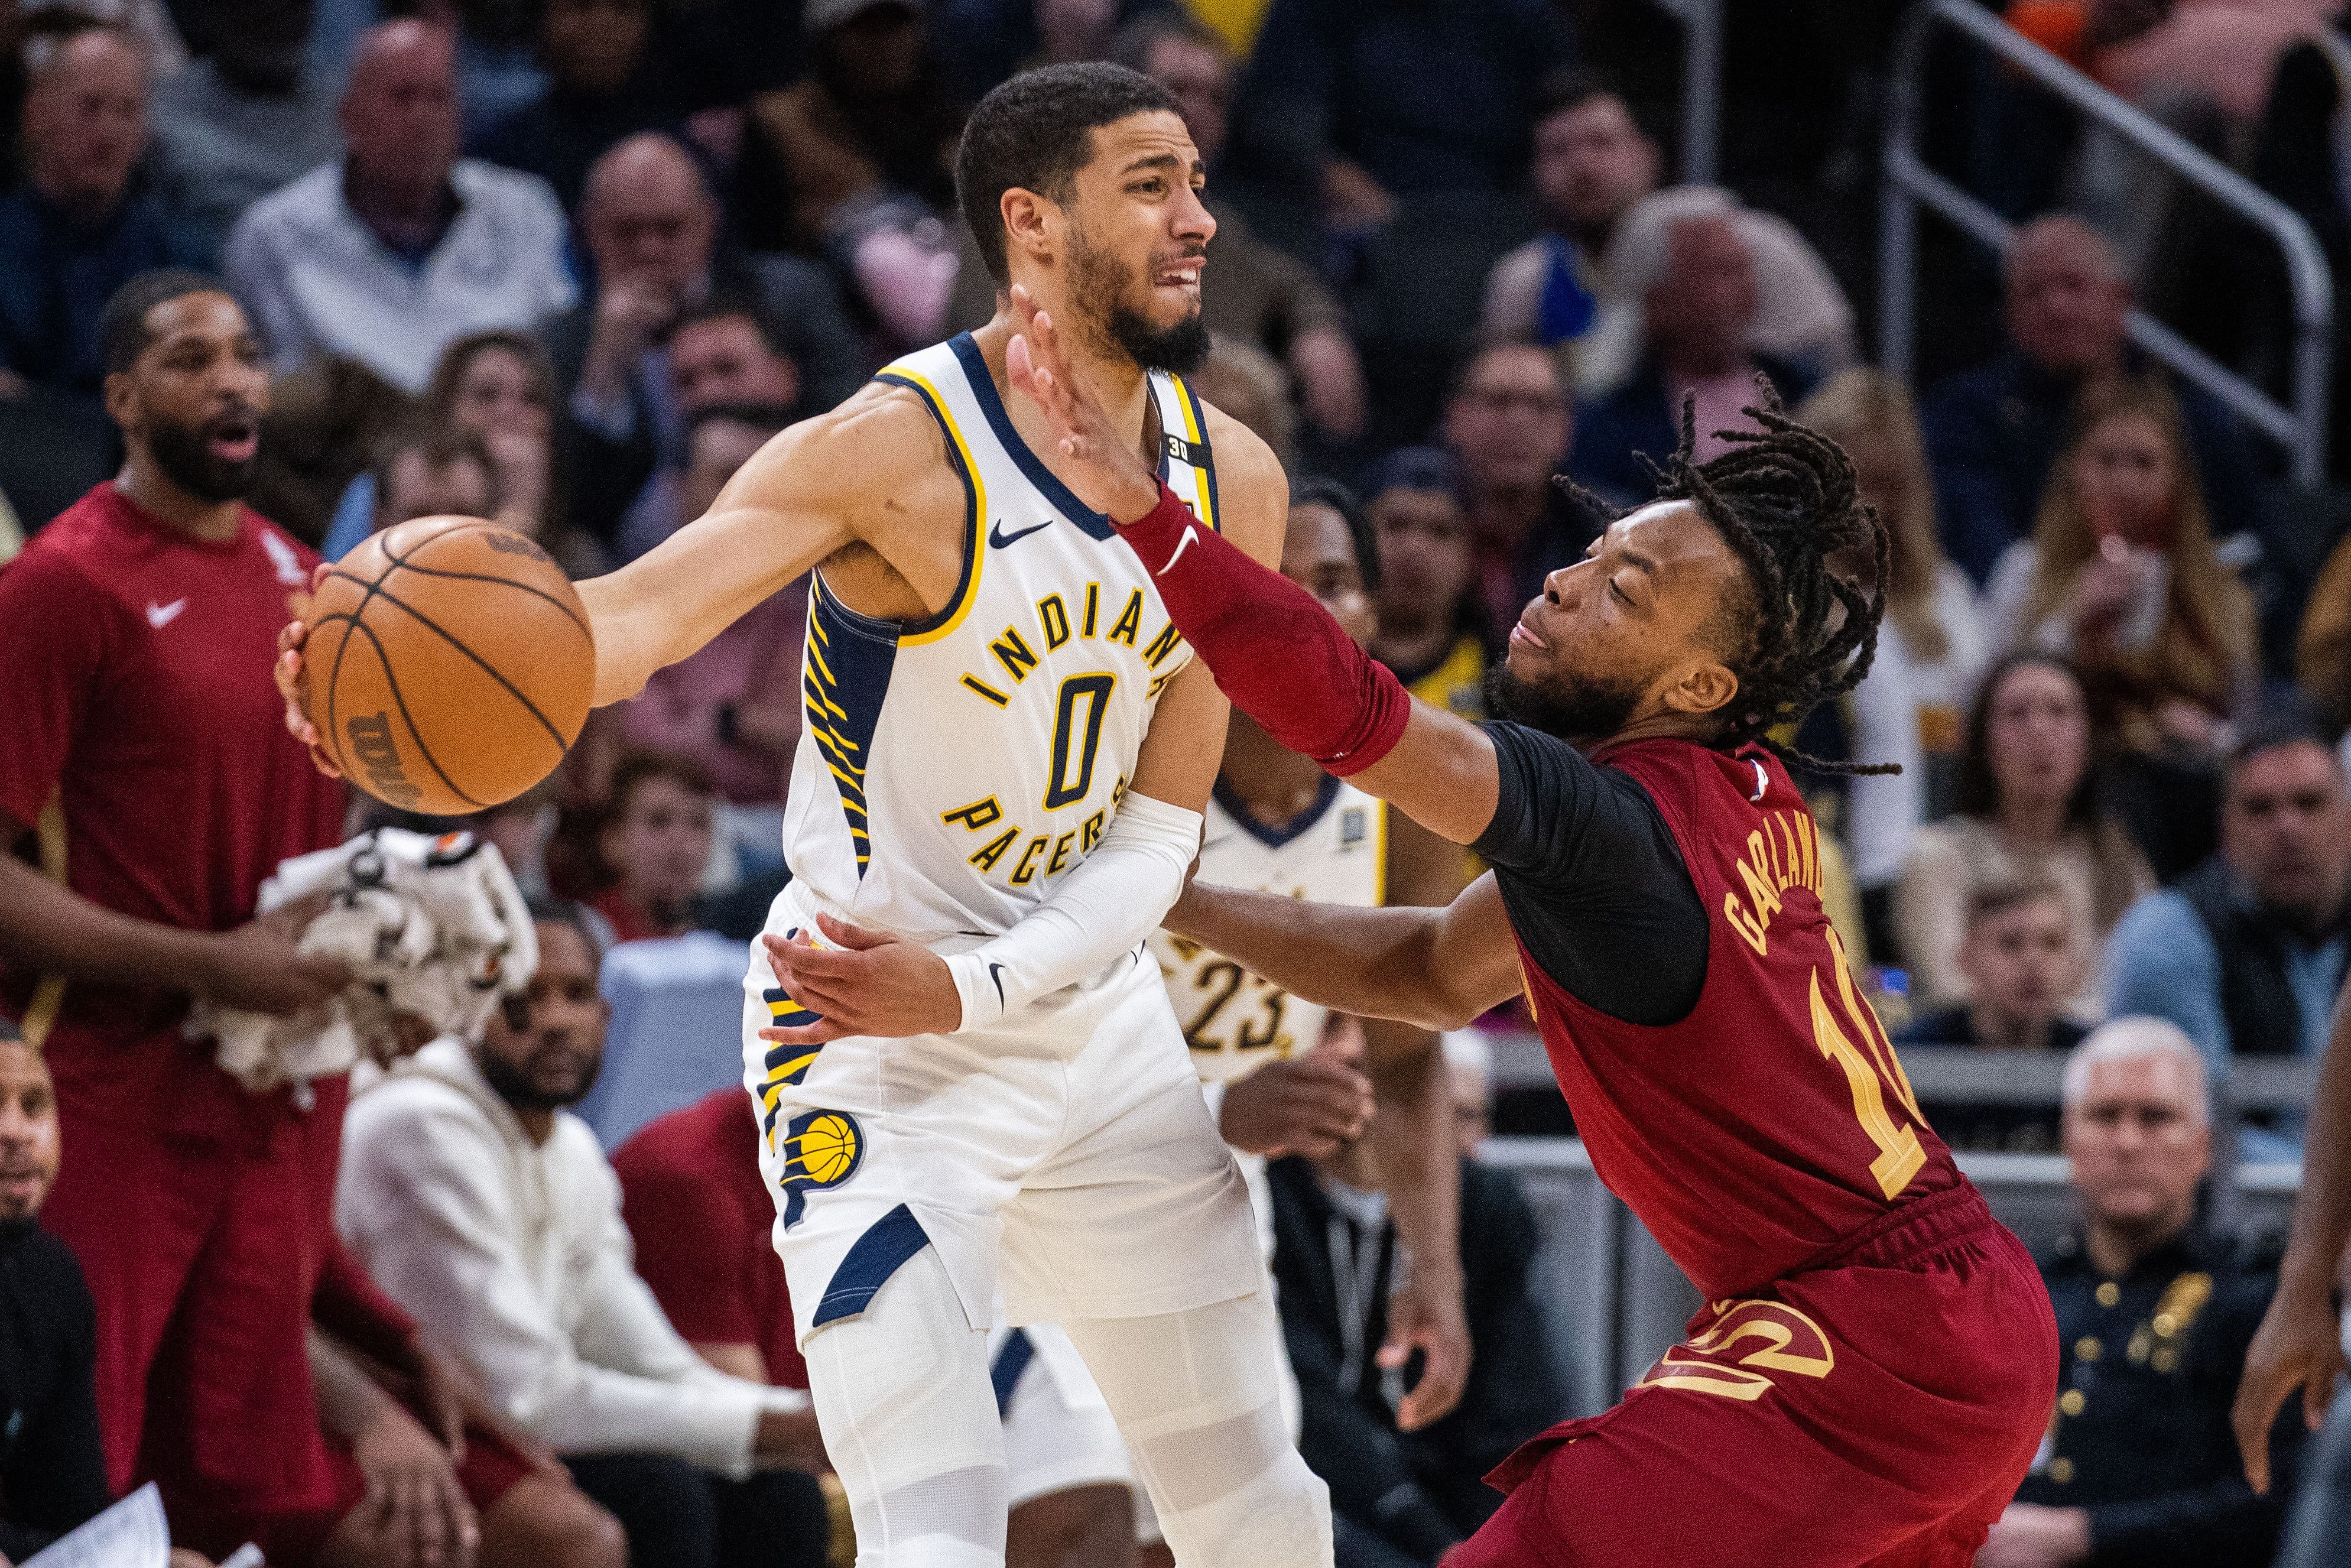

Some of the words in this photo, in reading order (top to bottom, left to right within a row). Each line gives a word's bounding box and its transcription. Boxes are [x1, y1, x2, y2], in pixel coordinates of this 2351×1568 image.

[1168, 436, 1189, 462] 30
[1042, 671, 1117, 812] 0
[1724, 809, 1824, 956] GARLAN
[1182, 959, 1288, 1054] 23
